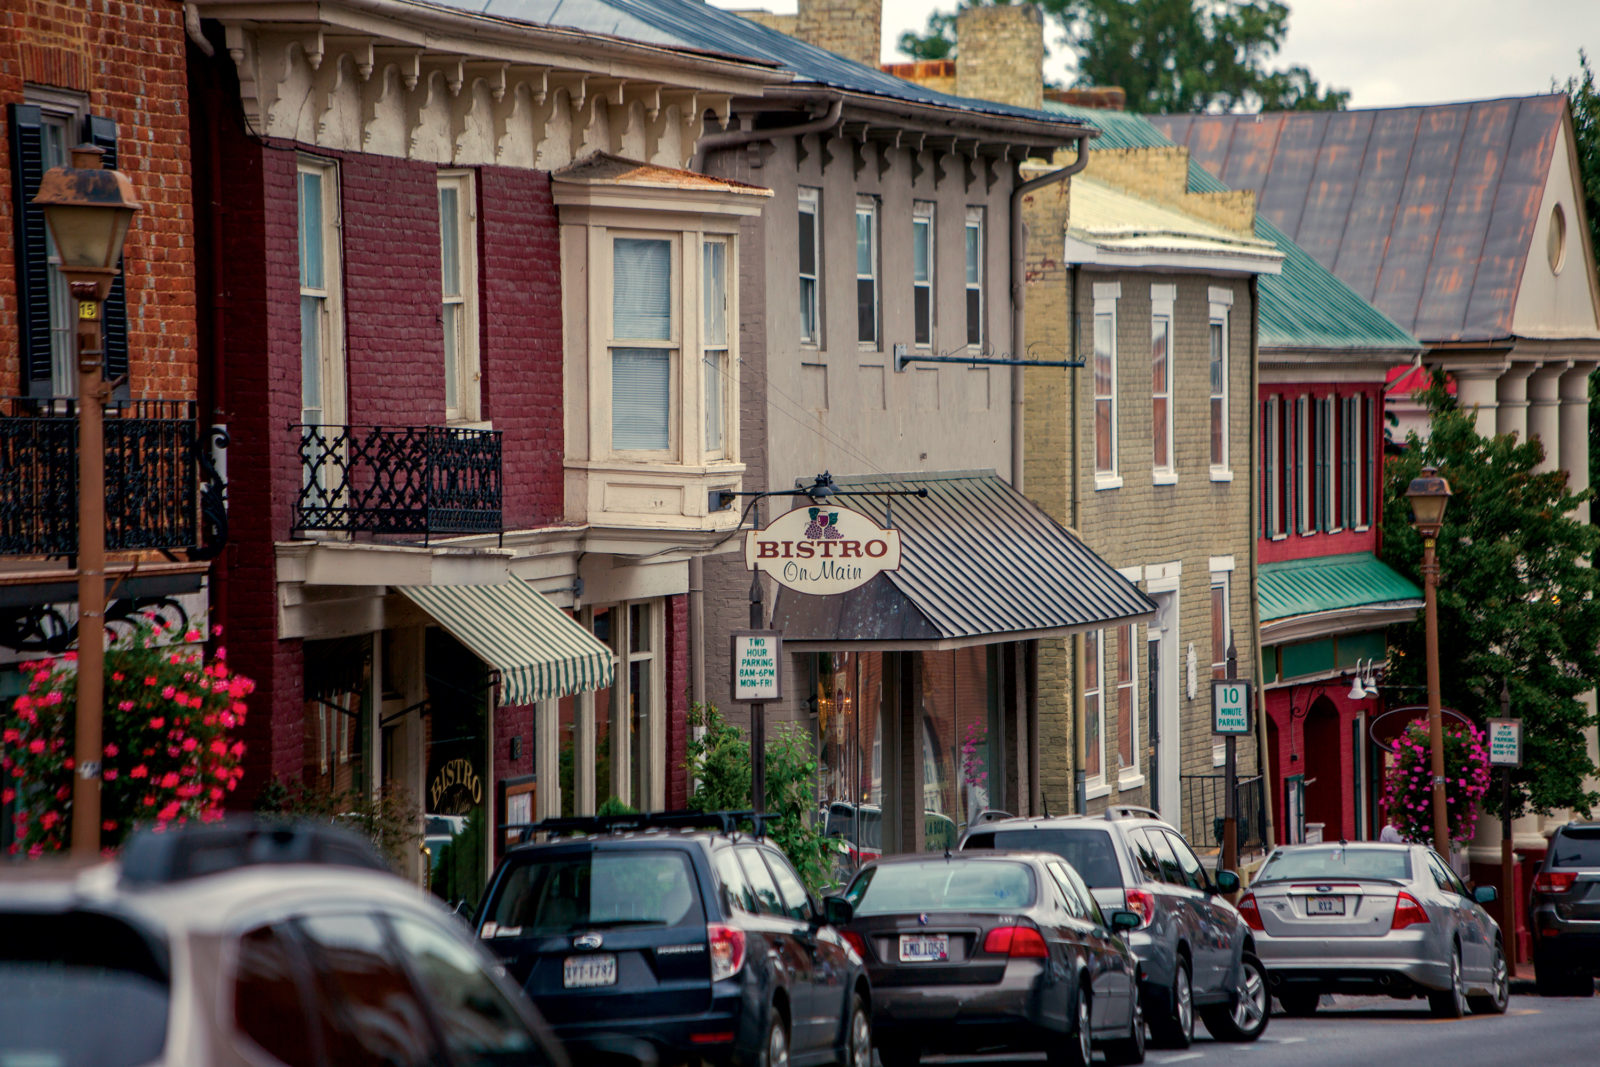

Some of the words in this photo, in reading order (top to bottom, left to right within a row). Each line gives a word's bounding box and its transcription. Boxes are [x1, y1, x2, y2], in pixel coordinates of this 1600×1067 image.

[80, 304, 94, 316] 15
[756, 540, 888, 558] BISTRO
[783, 560, 808, 583] On
[809, 560, 862, 581] Main
[749, 638, 765, 647] TWO
[746, 648, 767, 657] HOUR
[741, 658, 773, 667] PARKING
[739, 668, 775, 677] 8AM-6PM
[740, 679, 773, 688] MON-FRI
[1223, 688, 1239, 703] 10
[1221, 708, 1241, 716] MINUTE
[1218, 718, 1245, 727] PARKING
[430, 758, 482, 810] BISTRO
